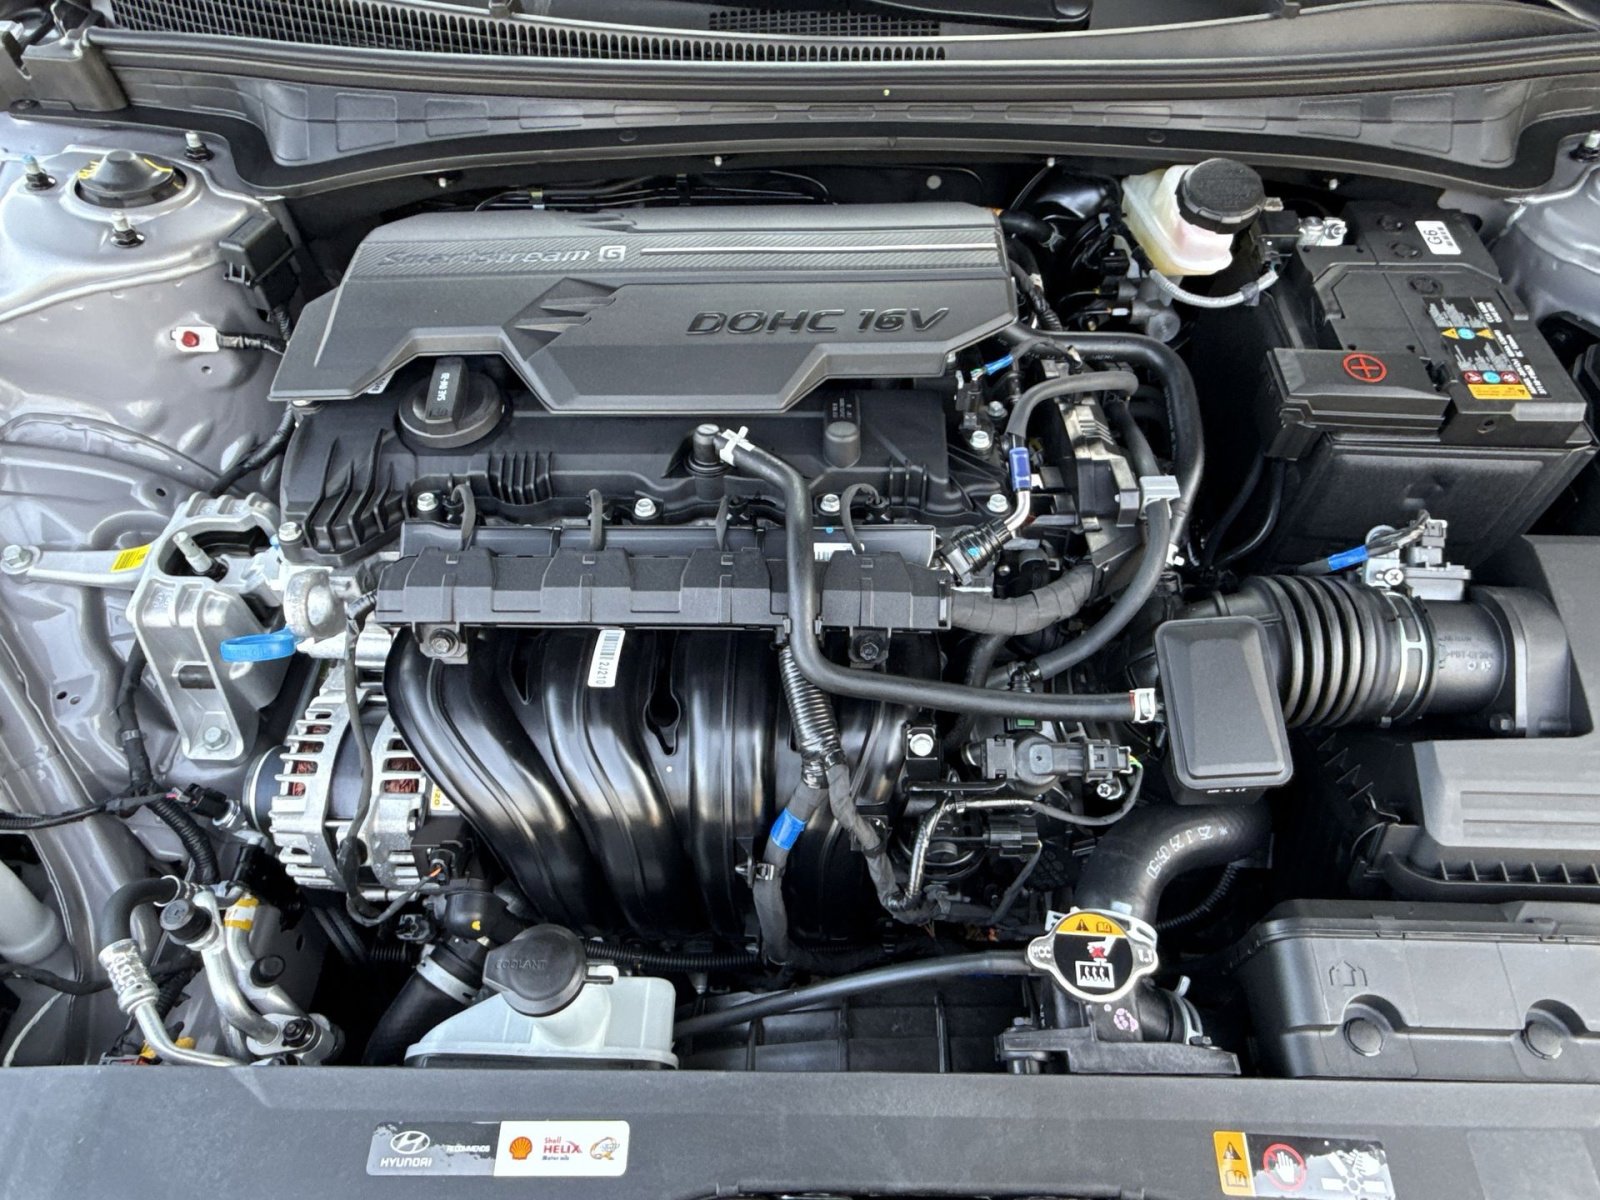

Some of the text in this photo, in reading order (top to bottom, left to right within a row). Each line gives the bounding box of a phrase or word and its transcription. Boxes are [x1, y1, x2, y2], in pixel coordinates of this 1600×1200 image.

[1422, 229, 1443, 245] G6
[686, 307, 949, 334] DOHC 16V
[436, 390, 448, 401] SAE
[1197, 825, 1213, 840] 25
[1169, 834, 1185, 852] 29
[494, 959, 548, 970] COOLANT
[544, 1136, 562, 1144] Shell
[543, 1143, 583, 1154] HELIX
[380, 1157, 433, 1169] HYUNDAI
